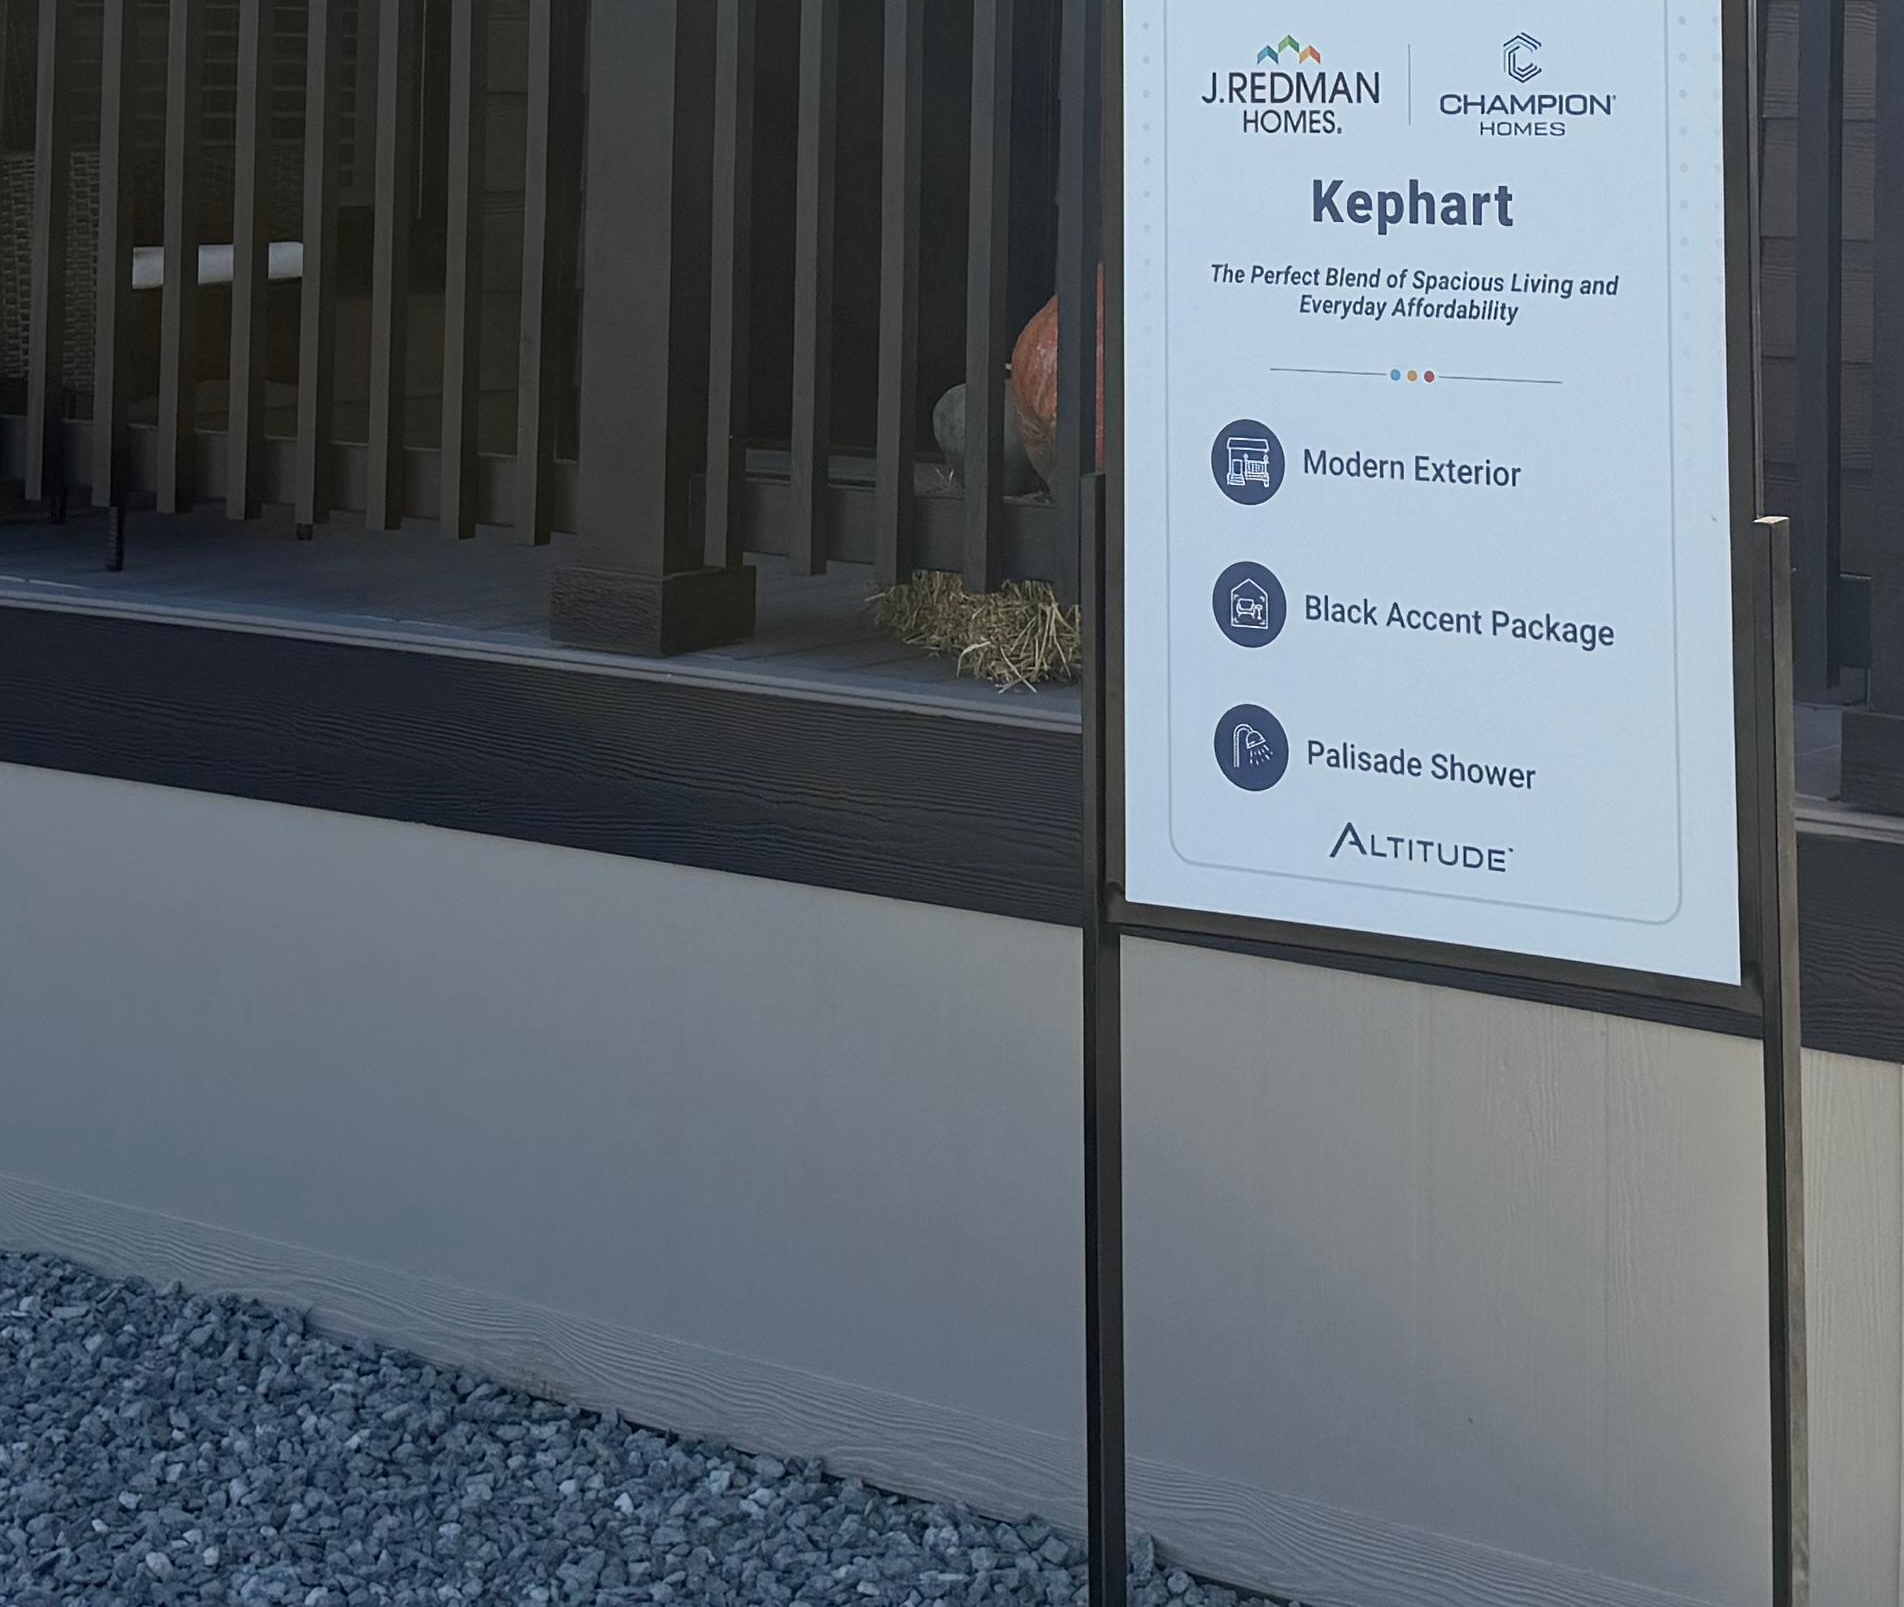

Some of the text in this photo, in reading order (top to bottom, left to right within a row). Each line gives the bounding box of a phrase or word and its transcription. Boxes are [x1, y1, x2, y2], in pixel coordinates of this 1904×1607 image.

[1201, 71, 1380, 104] J.REDMAN
[1439, 93, 1613, 116] CHAMPION
[1480, 121, 1566, 137] HOMES
[1313, 178, 1514, 236] Kephart
[1211, 263, 1620, 300] The Perfect Blend of Spacious Living and
[1299, 294, 1519, 326] Everyday Affordability
[1304, 448, 1522, 487] Modern Exterior
[1305, 594, 1615, 652] Black Accent Package
[1307, 739, 1536, 790] Palisade Shower
